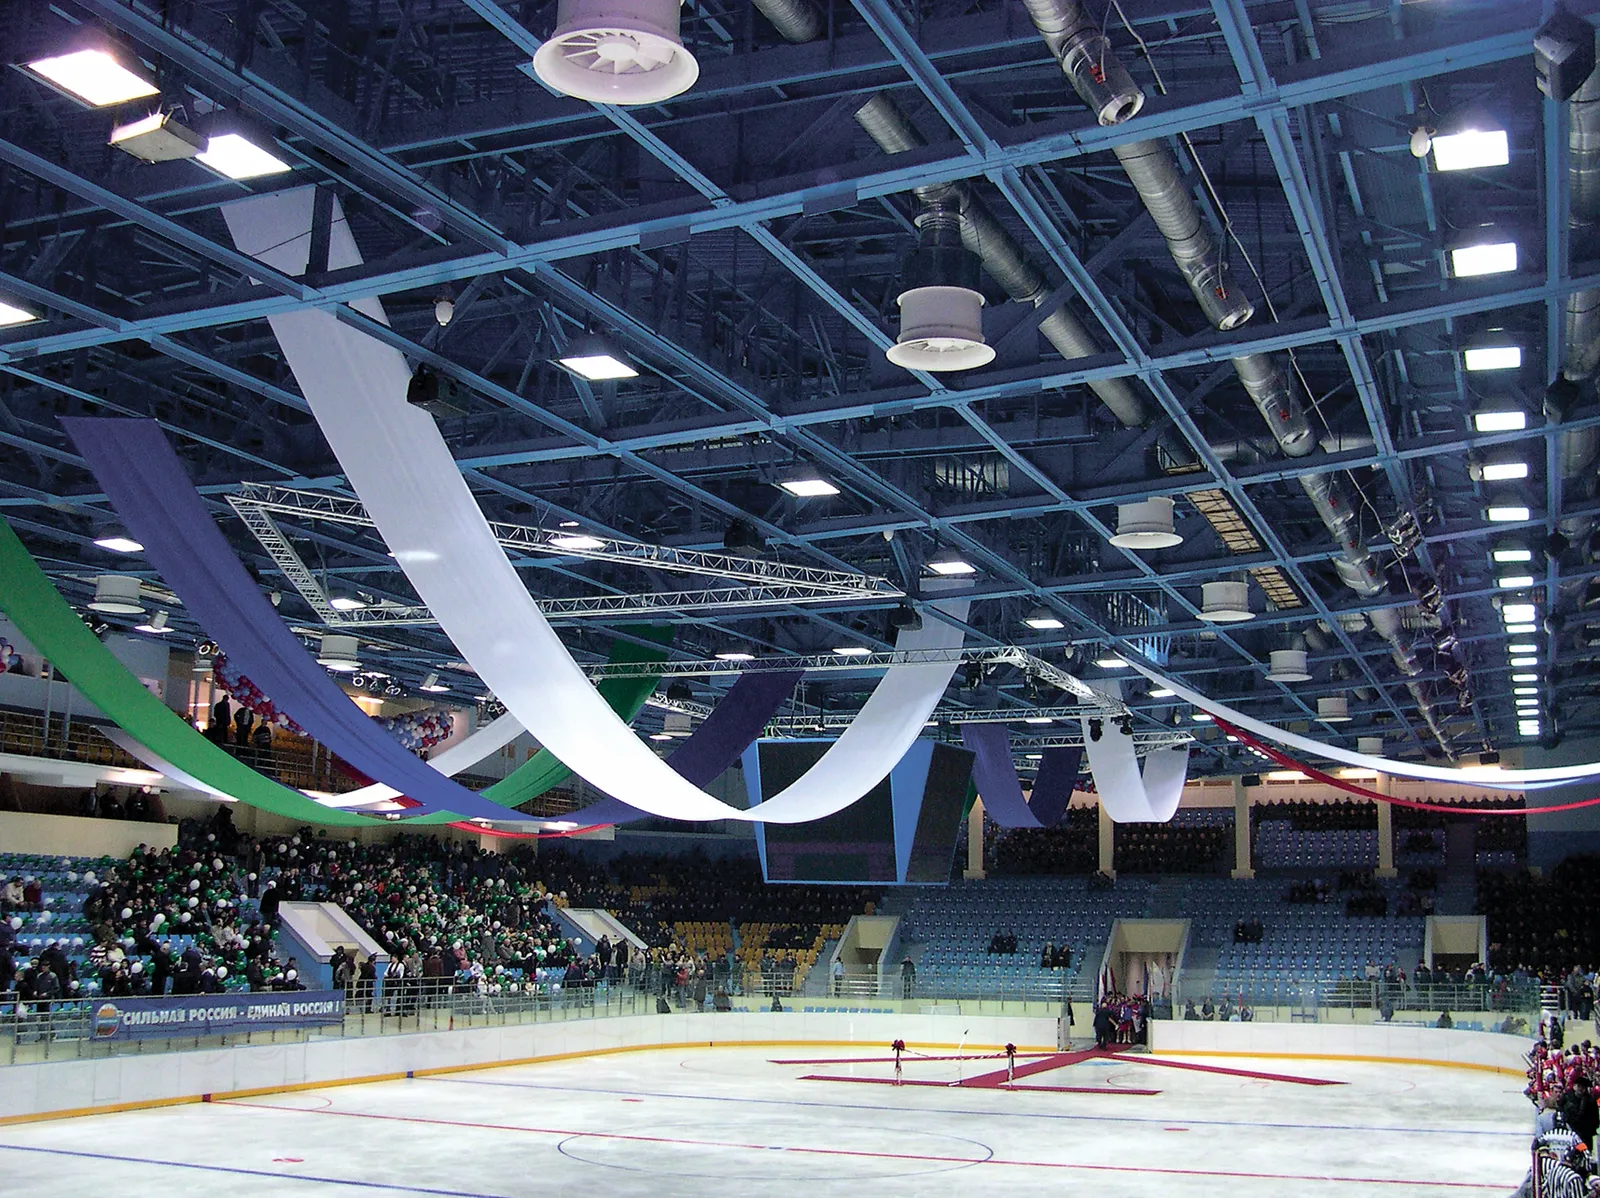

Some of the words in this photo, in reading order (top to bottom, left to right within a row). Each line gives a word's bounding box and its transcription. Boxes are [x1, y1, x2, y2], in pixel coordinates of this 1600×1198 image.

[123, 1009, 186, 1025] СИЛЬНАЯ
[189, 1006, 237, 1021] РОССИЯ
[247, 1003, 291, 1019] ЕДИНАЯ
[293, 1001, 333, 1015] РОССИЯ
